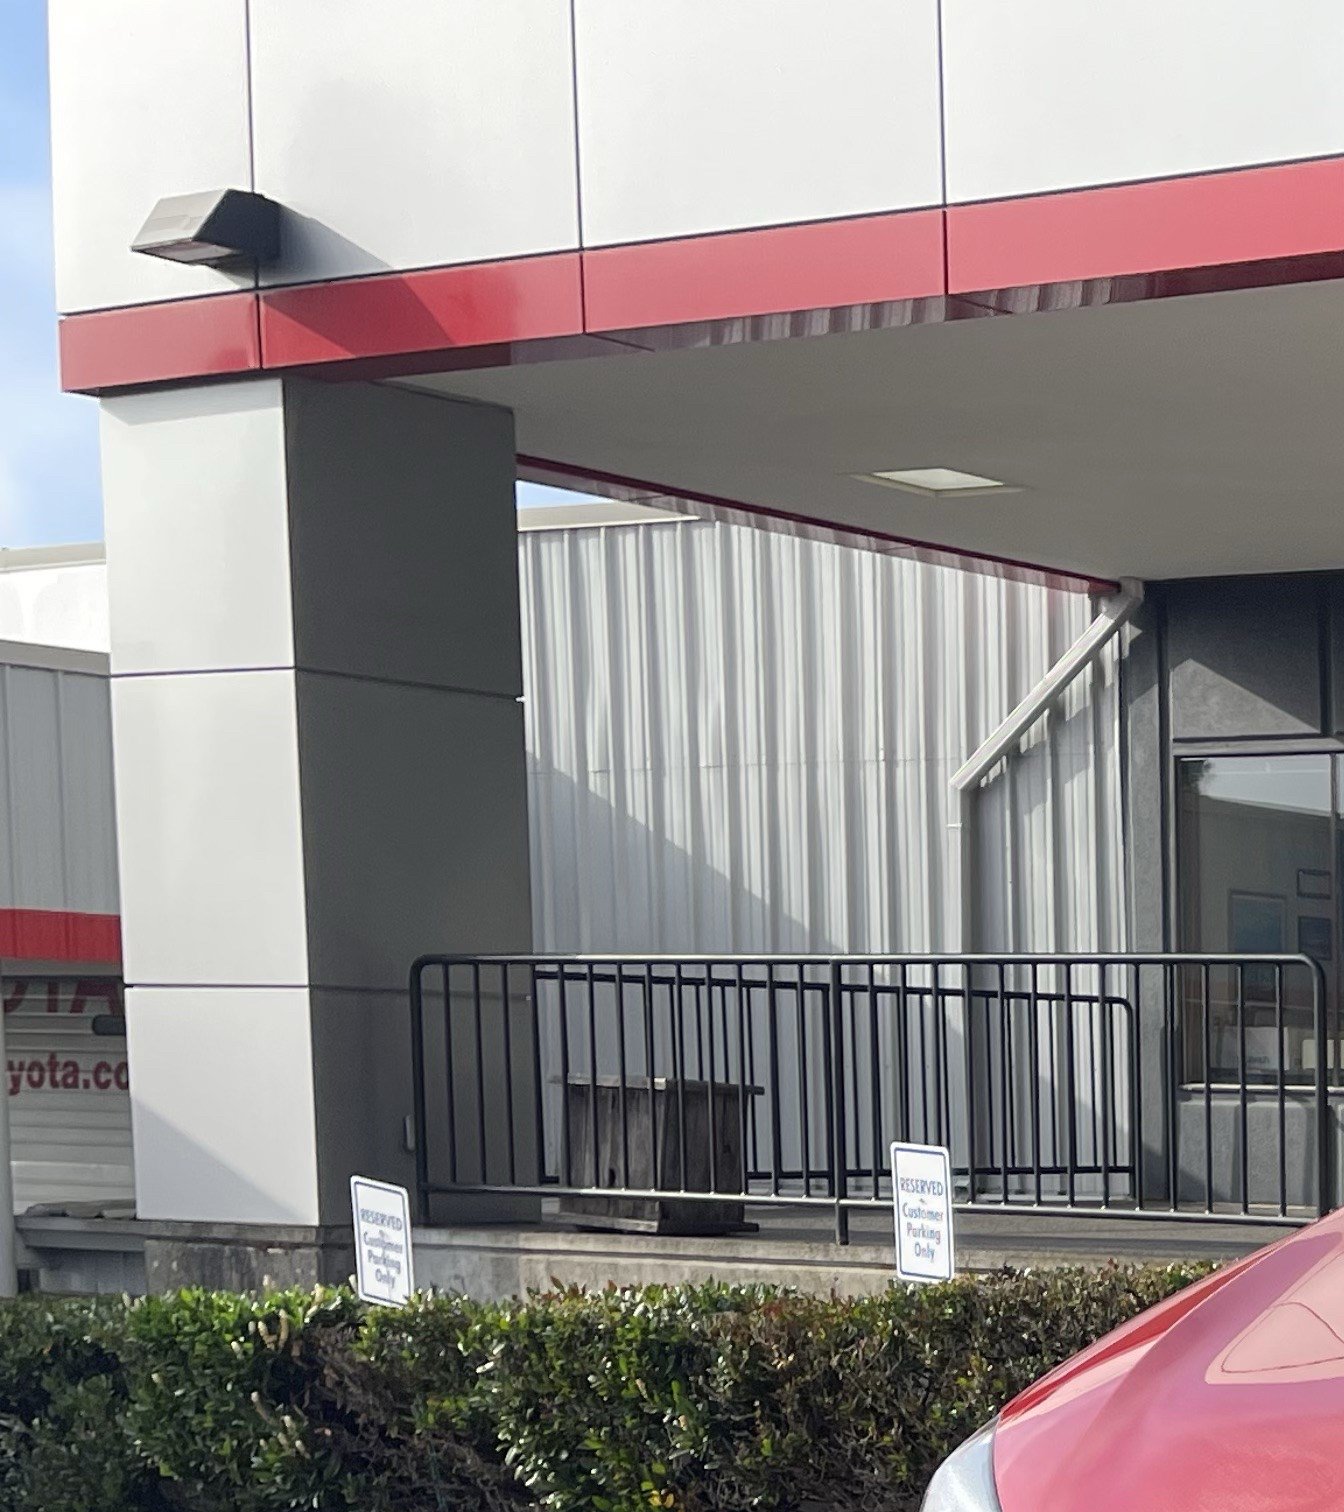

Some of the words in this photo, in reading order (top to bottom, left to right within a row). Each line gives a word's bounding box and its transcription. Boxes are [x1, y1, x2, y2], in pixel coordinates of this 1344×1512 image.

[900, 1177, 943, 1197] RESERVED
[902, 1202, 943, 1221] Customer
[906, 1222, 941, 1245] Parking
[914, 1242, 936, 1263] Only
